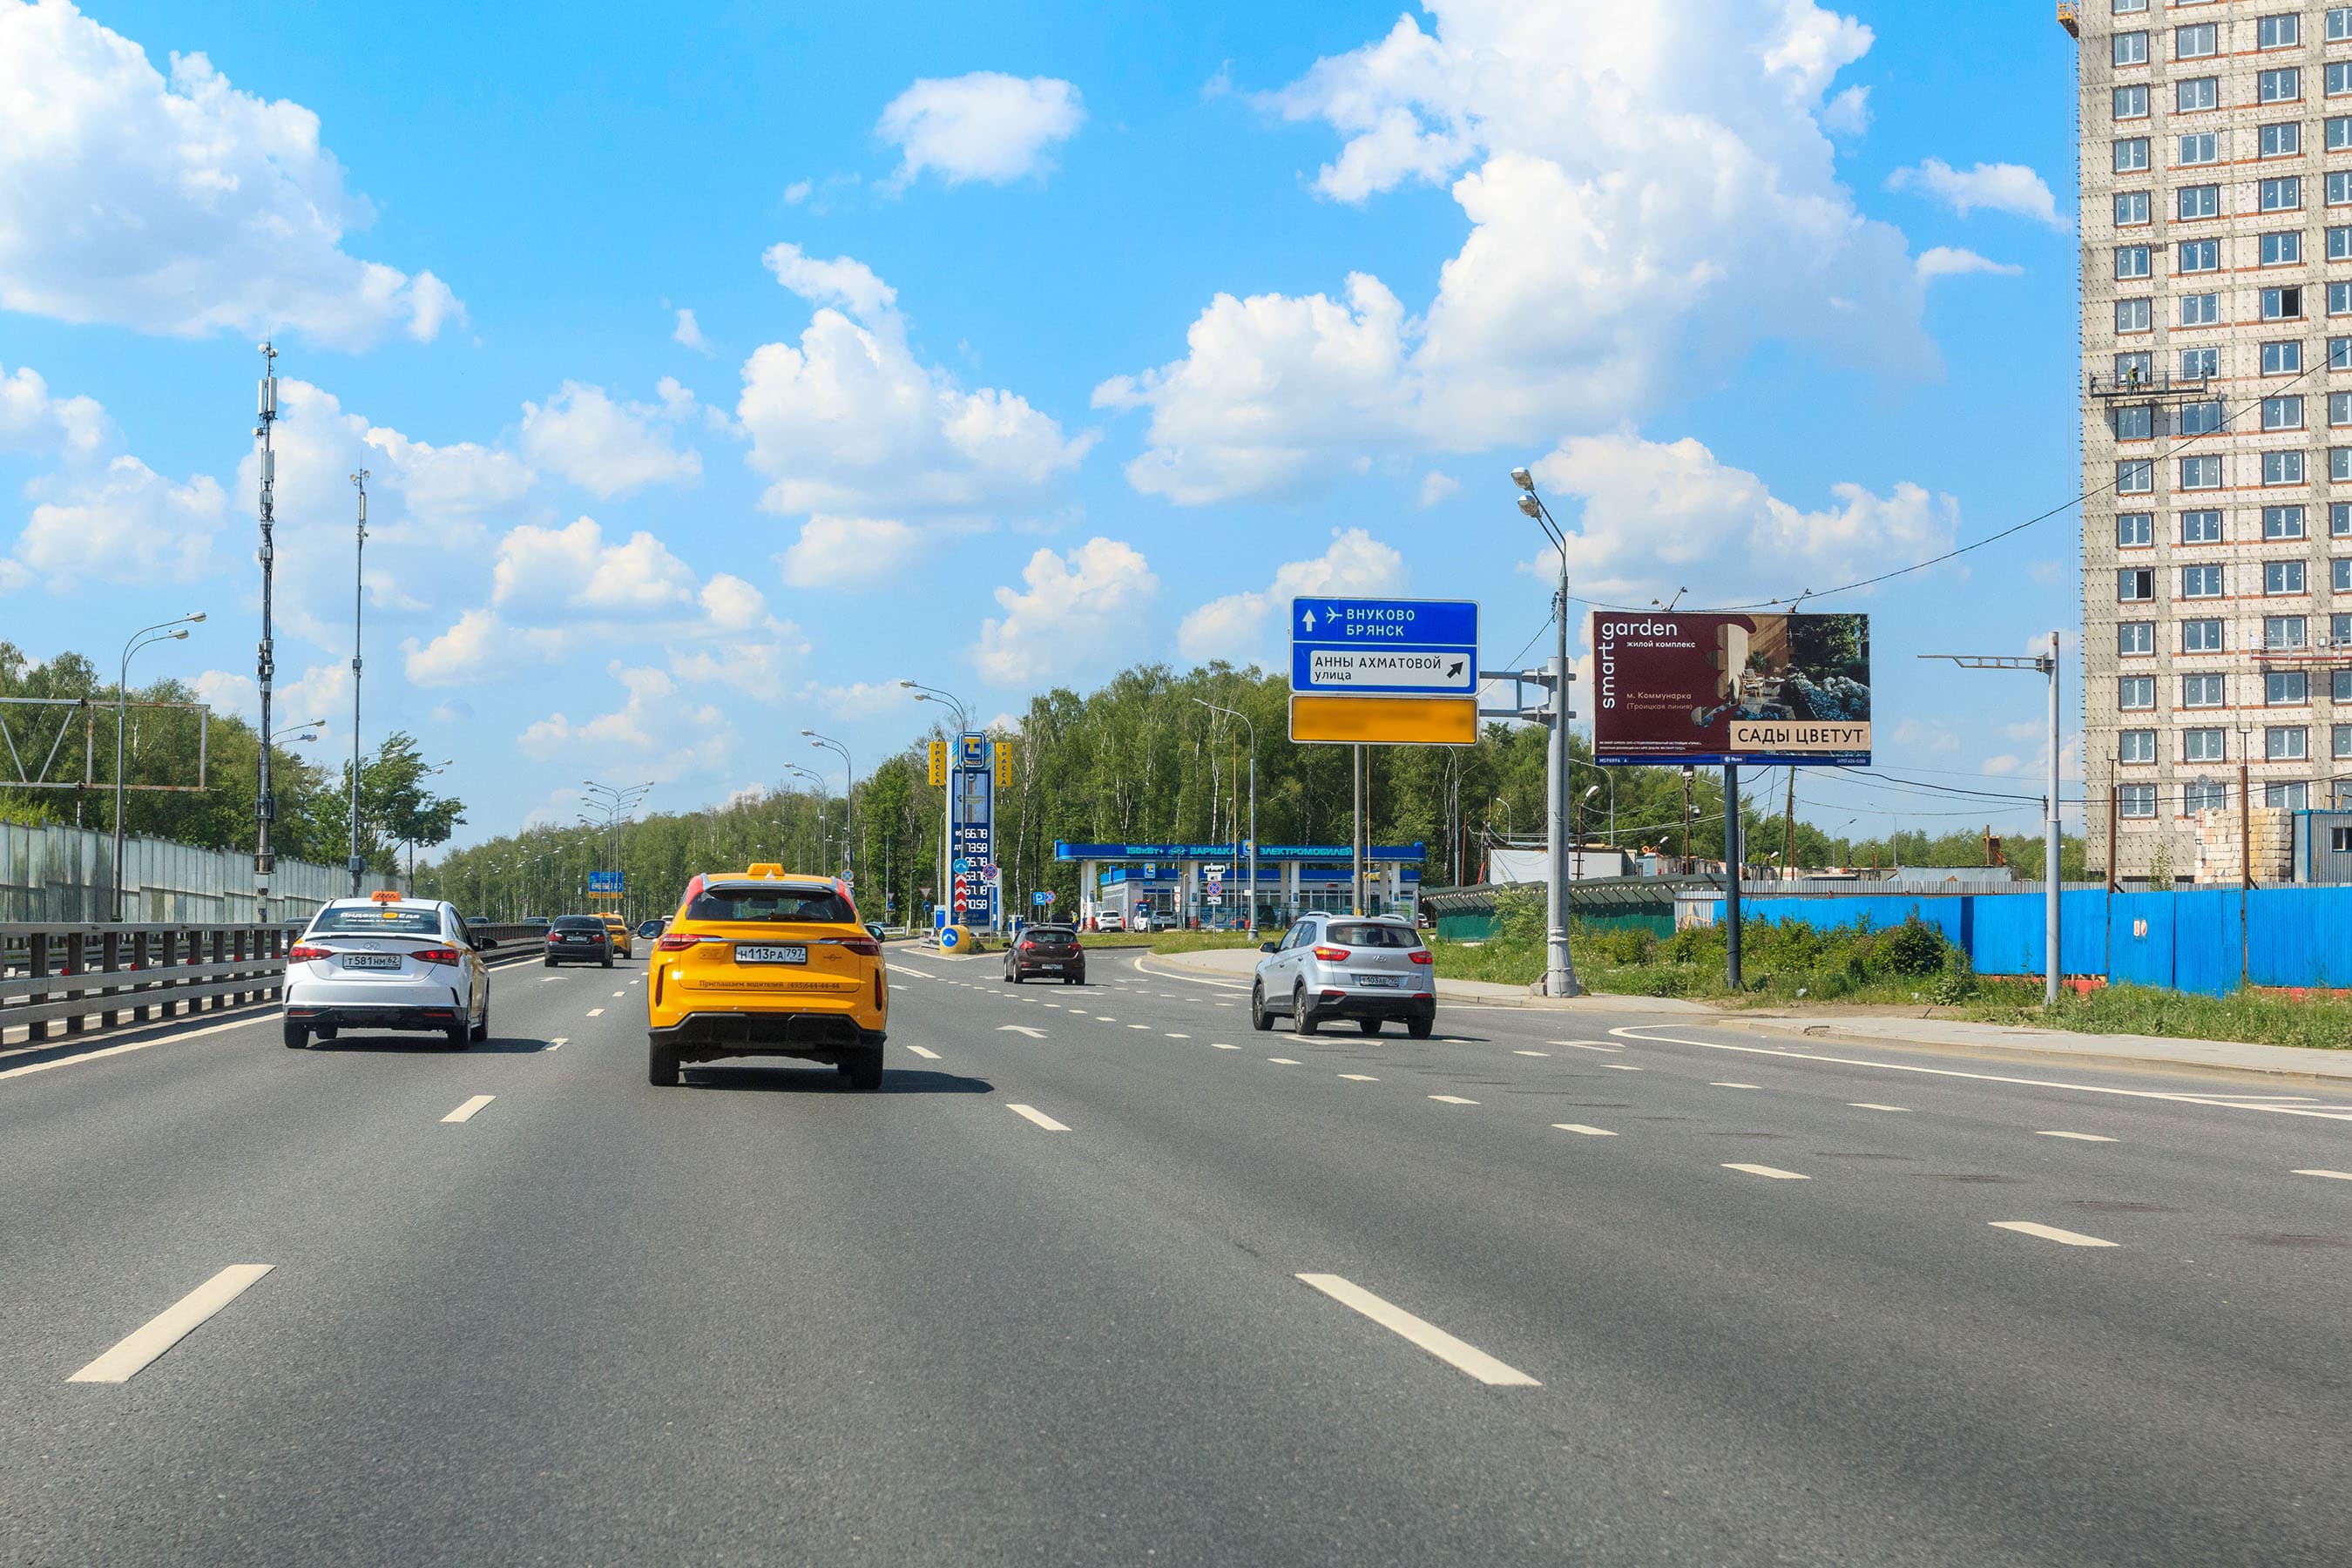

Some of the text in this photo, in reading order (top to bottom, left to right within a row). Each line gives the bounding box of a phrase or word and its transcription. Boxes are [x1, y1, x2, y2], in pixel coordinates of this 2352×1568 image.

[1347, 609, 1415, 621] ВНУКОВО
[1347, 625, 1404, 637] БРЯНСК
[1602, 618, 1678, 640] garden
[1315, 655, 1442, 669] АННЫ АХМАТОВОЙ
[1315, 672, 1351, 681] улица
[1598, 642, 1615, 709] smart
[1638, 692, 1692, 700] Коммунарка
[1738, 728, 1864, 745] САДЫ ЦВЕТУТ
[1190, 847, 1236, 855] ЗАРЯДКА
[1260, 847, 1353, 856] ЭЛЕКТРОМОБИЛЕЙ
[348, 956, 385, 965] Т581НМ
[740, 948, 802, 961] Н113РА 797
